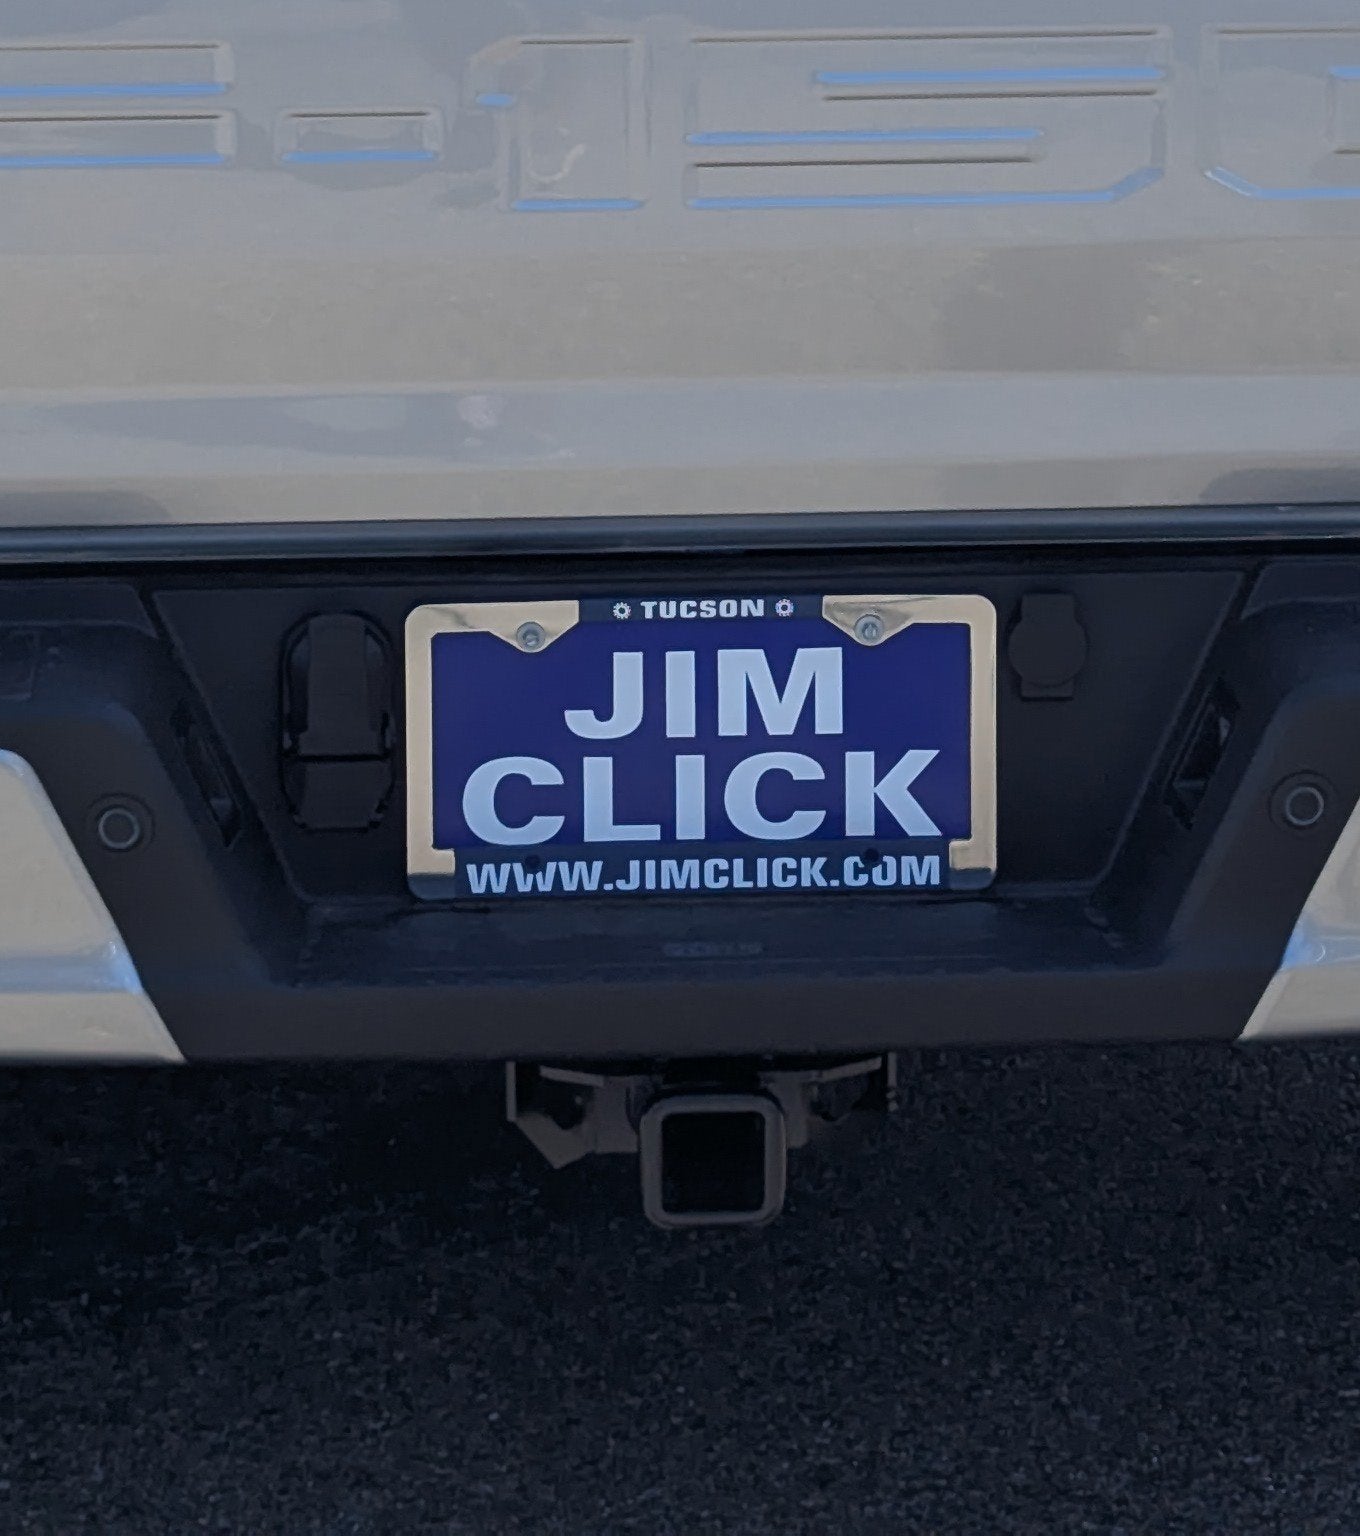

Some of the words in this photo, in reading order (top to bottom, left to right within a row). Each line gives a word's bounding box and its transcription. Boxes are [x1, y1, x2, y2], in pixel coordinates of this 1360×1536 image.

[640, 598, 766, 619] TUCSON
[563, 646, 844, 740] JIM
[462, 748, 942, 847] CLICK
[467, 854, 941, 894] WWW.JIMCLICK.COM
